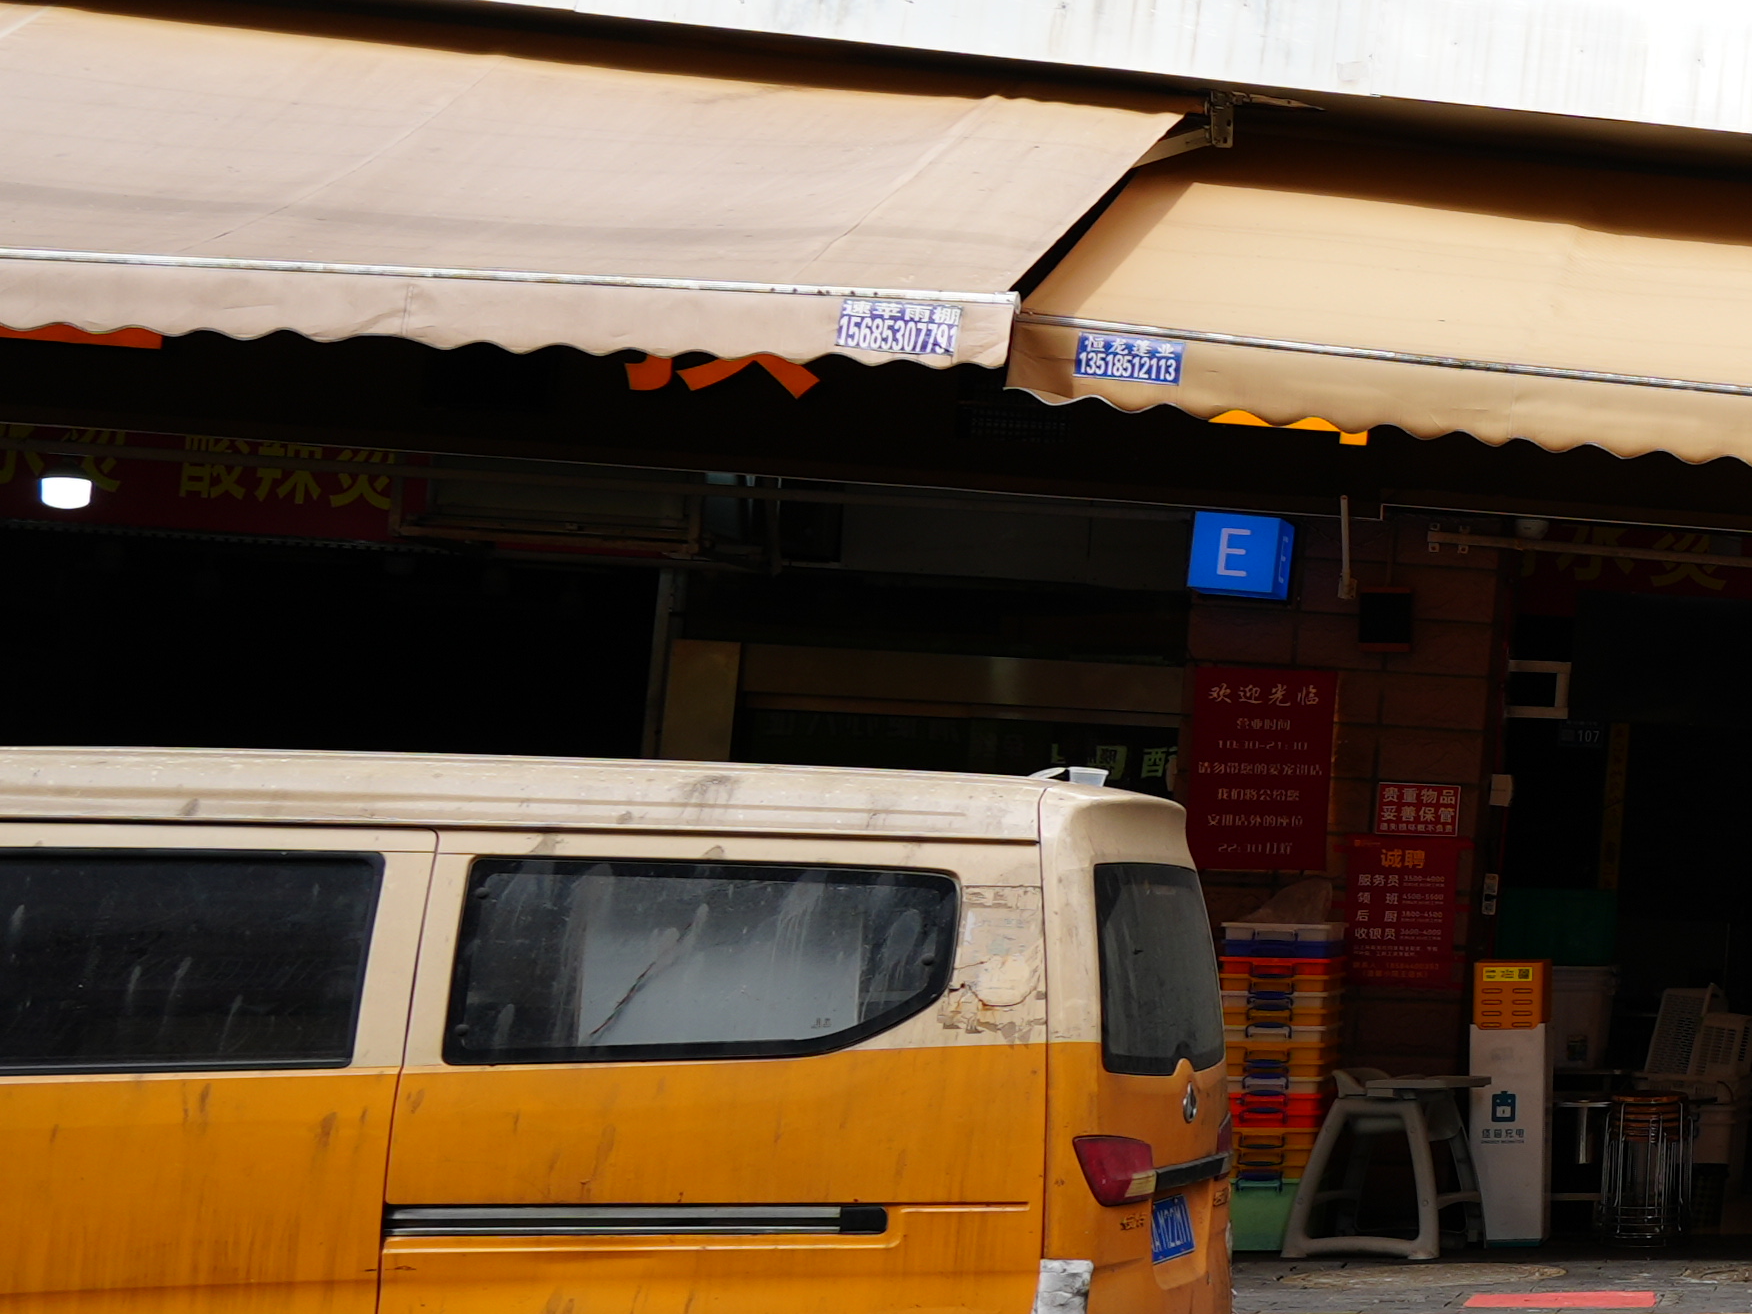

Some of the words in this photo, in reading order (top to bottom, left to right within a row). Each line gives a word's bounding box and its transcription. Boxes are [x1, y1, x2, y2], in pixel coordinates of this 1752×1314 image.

[1079, 351, 1177, 382] 13518512113
[1216, 527, 1254, 578] E
[1207, 682, 1320, 707] 欢迎光临
[1236, 717, 1291, 731] 营业时间
[1577, 729, 1600, 744] 107
[1217, 739, 1309, 751] 10:30-21:30
[1197, 761, 1324, 777] 请勿带您的爱宠进店
[1216, 787, 1300, 802] 我们将会给您
[1382, 786, 1456, 805] 贵重物品
[1207, 813, 1304, 827] 安排店外的座位
[1380, 805, 1456, 823] 妥善保管
[1380, 848, 1426, 870] 诚聘
[1357, 873, 1400, 887] 服务员
[1354, 927, 1396, 940] 收银员
